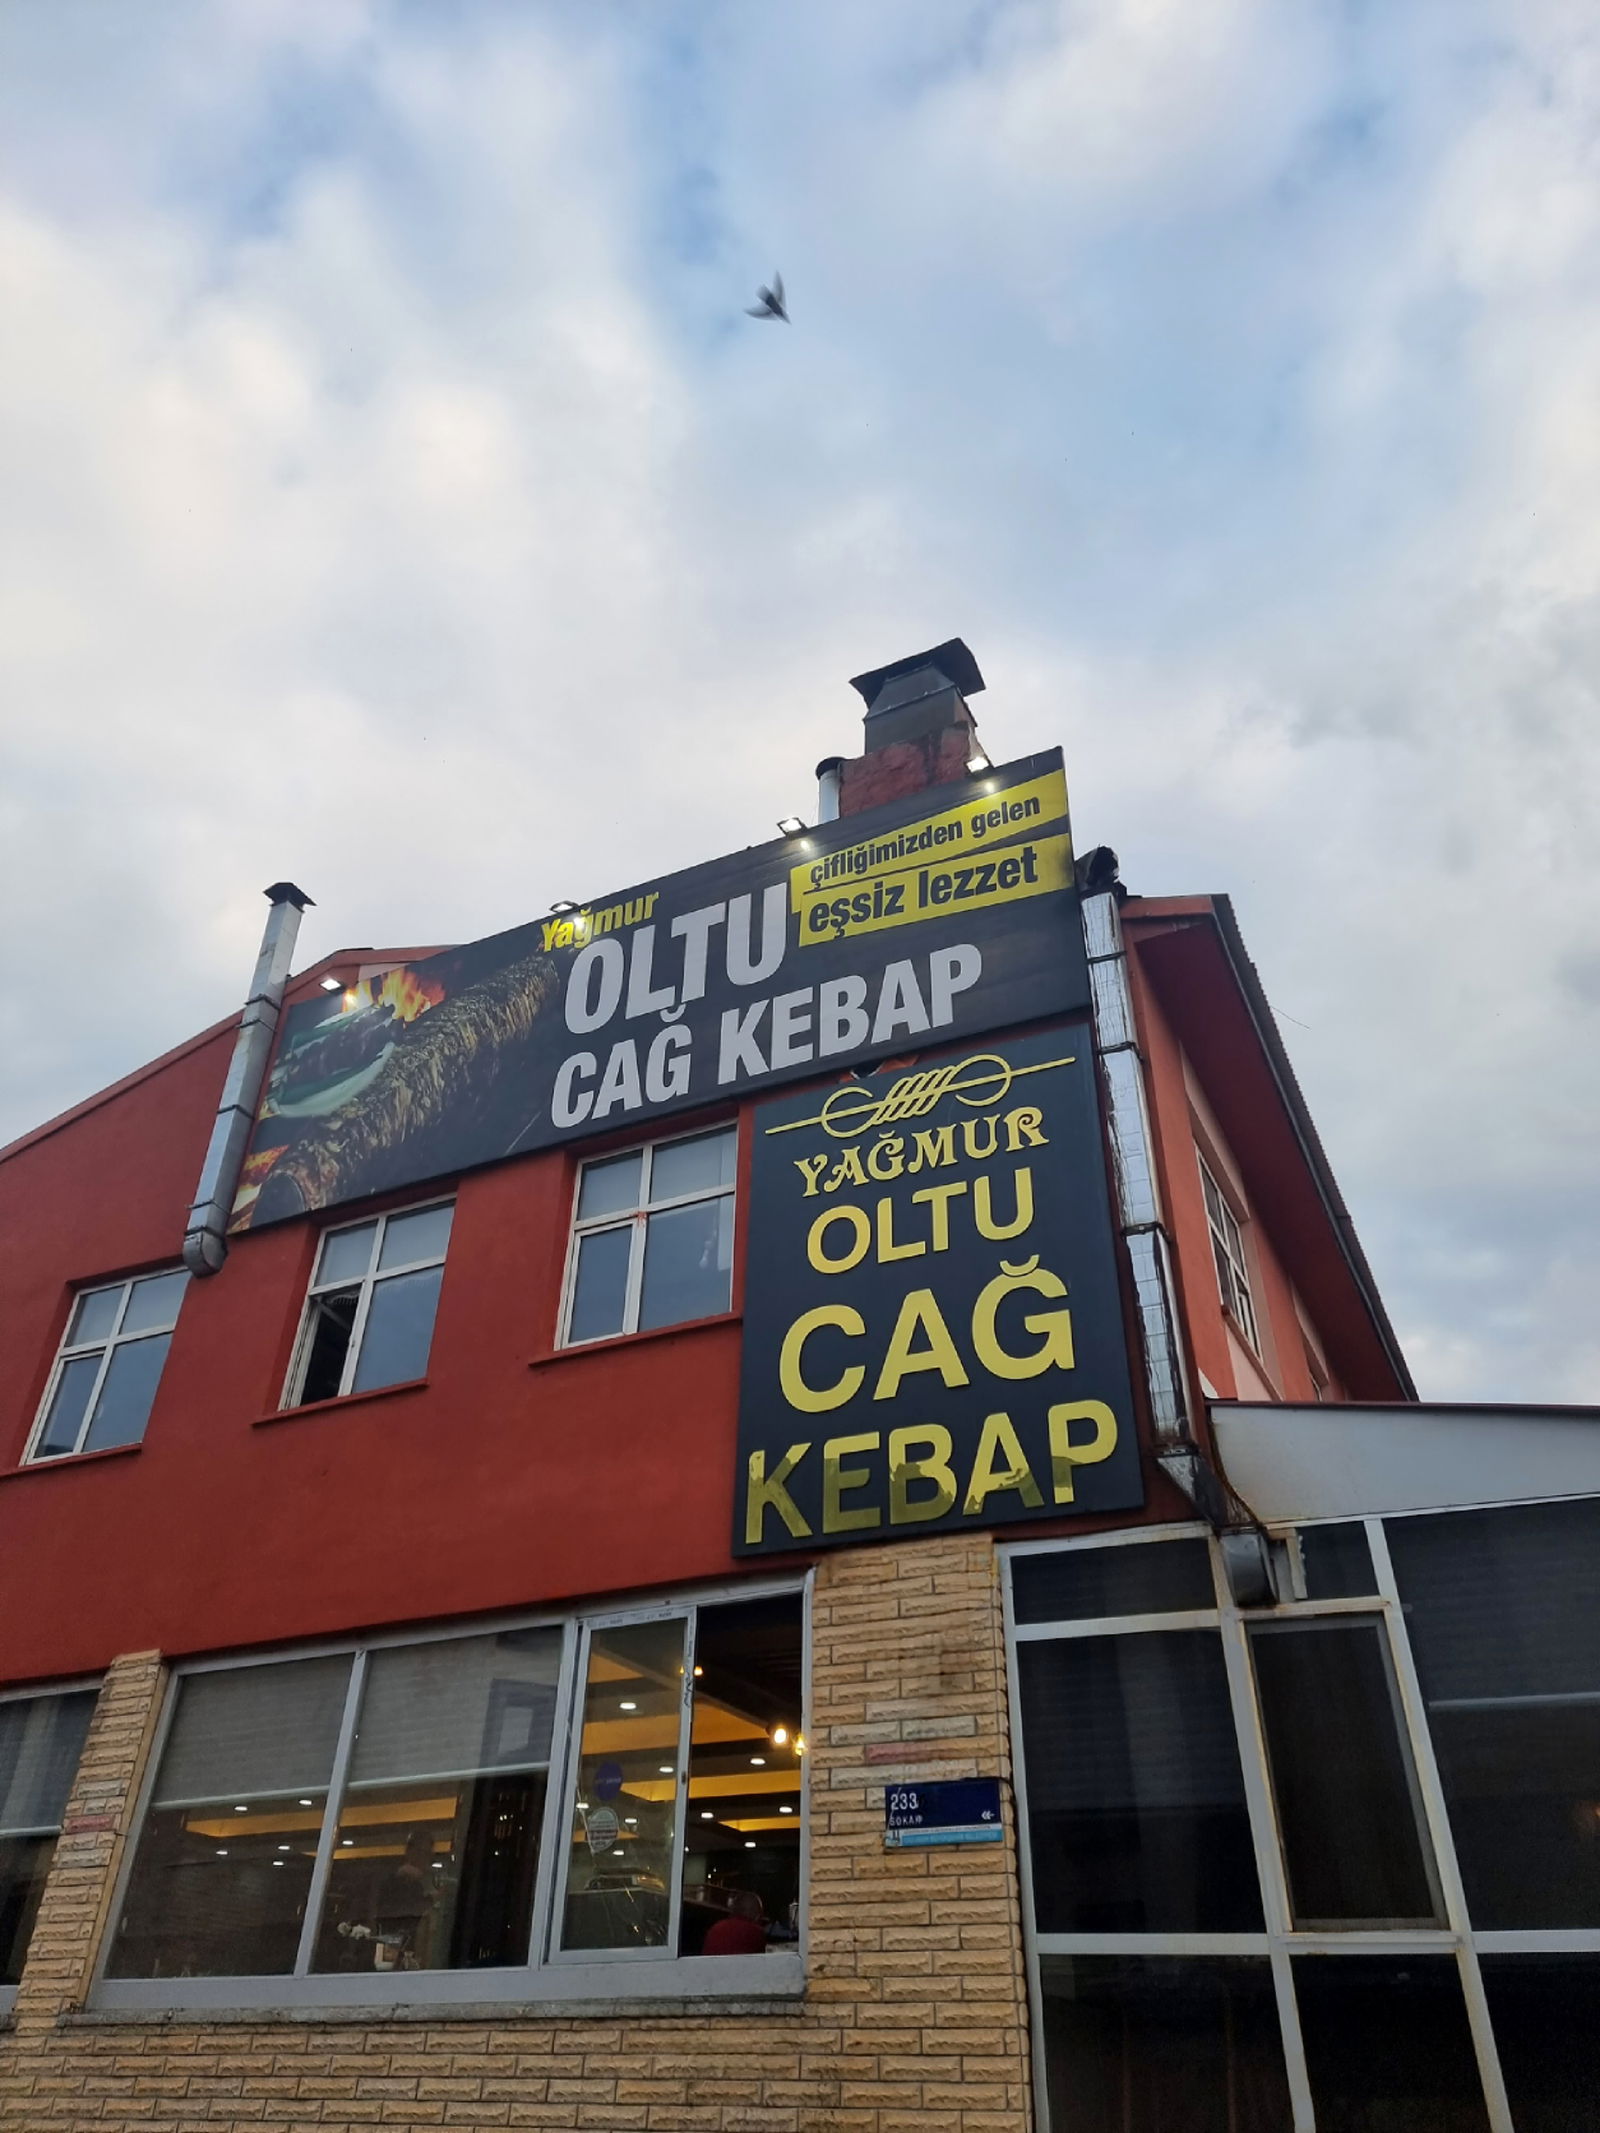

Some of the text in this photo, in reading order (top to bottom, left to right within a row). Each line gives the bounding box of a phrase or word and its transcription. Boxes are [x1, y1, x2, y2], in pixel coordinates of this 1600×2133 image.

[808, 845, 1039, 938] eşsiz lezzet
[810, 794, 1041, 890] çifliğimizden gelen
[541, 891, 660, 952] Yağmur
[564, 883, 787, 1035] OLTU
[551, 943, 983, 1129] CAĞ KEBAP
[794, 1106, 1049, 1197] YAĞMUR
[807, 1167, 1035, 1274] OLTU
[779, 1254, 1076, 1414] CAĞ
[745, 1400, 1118, 1544] KEBAP
